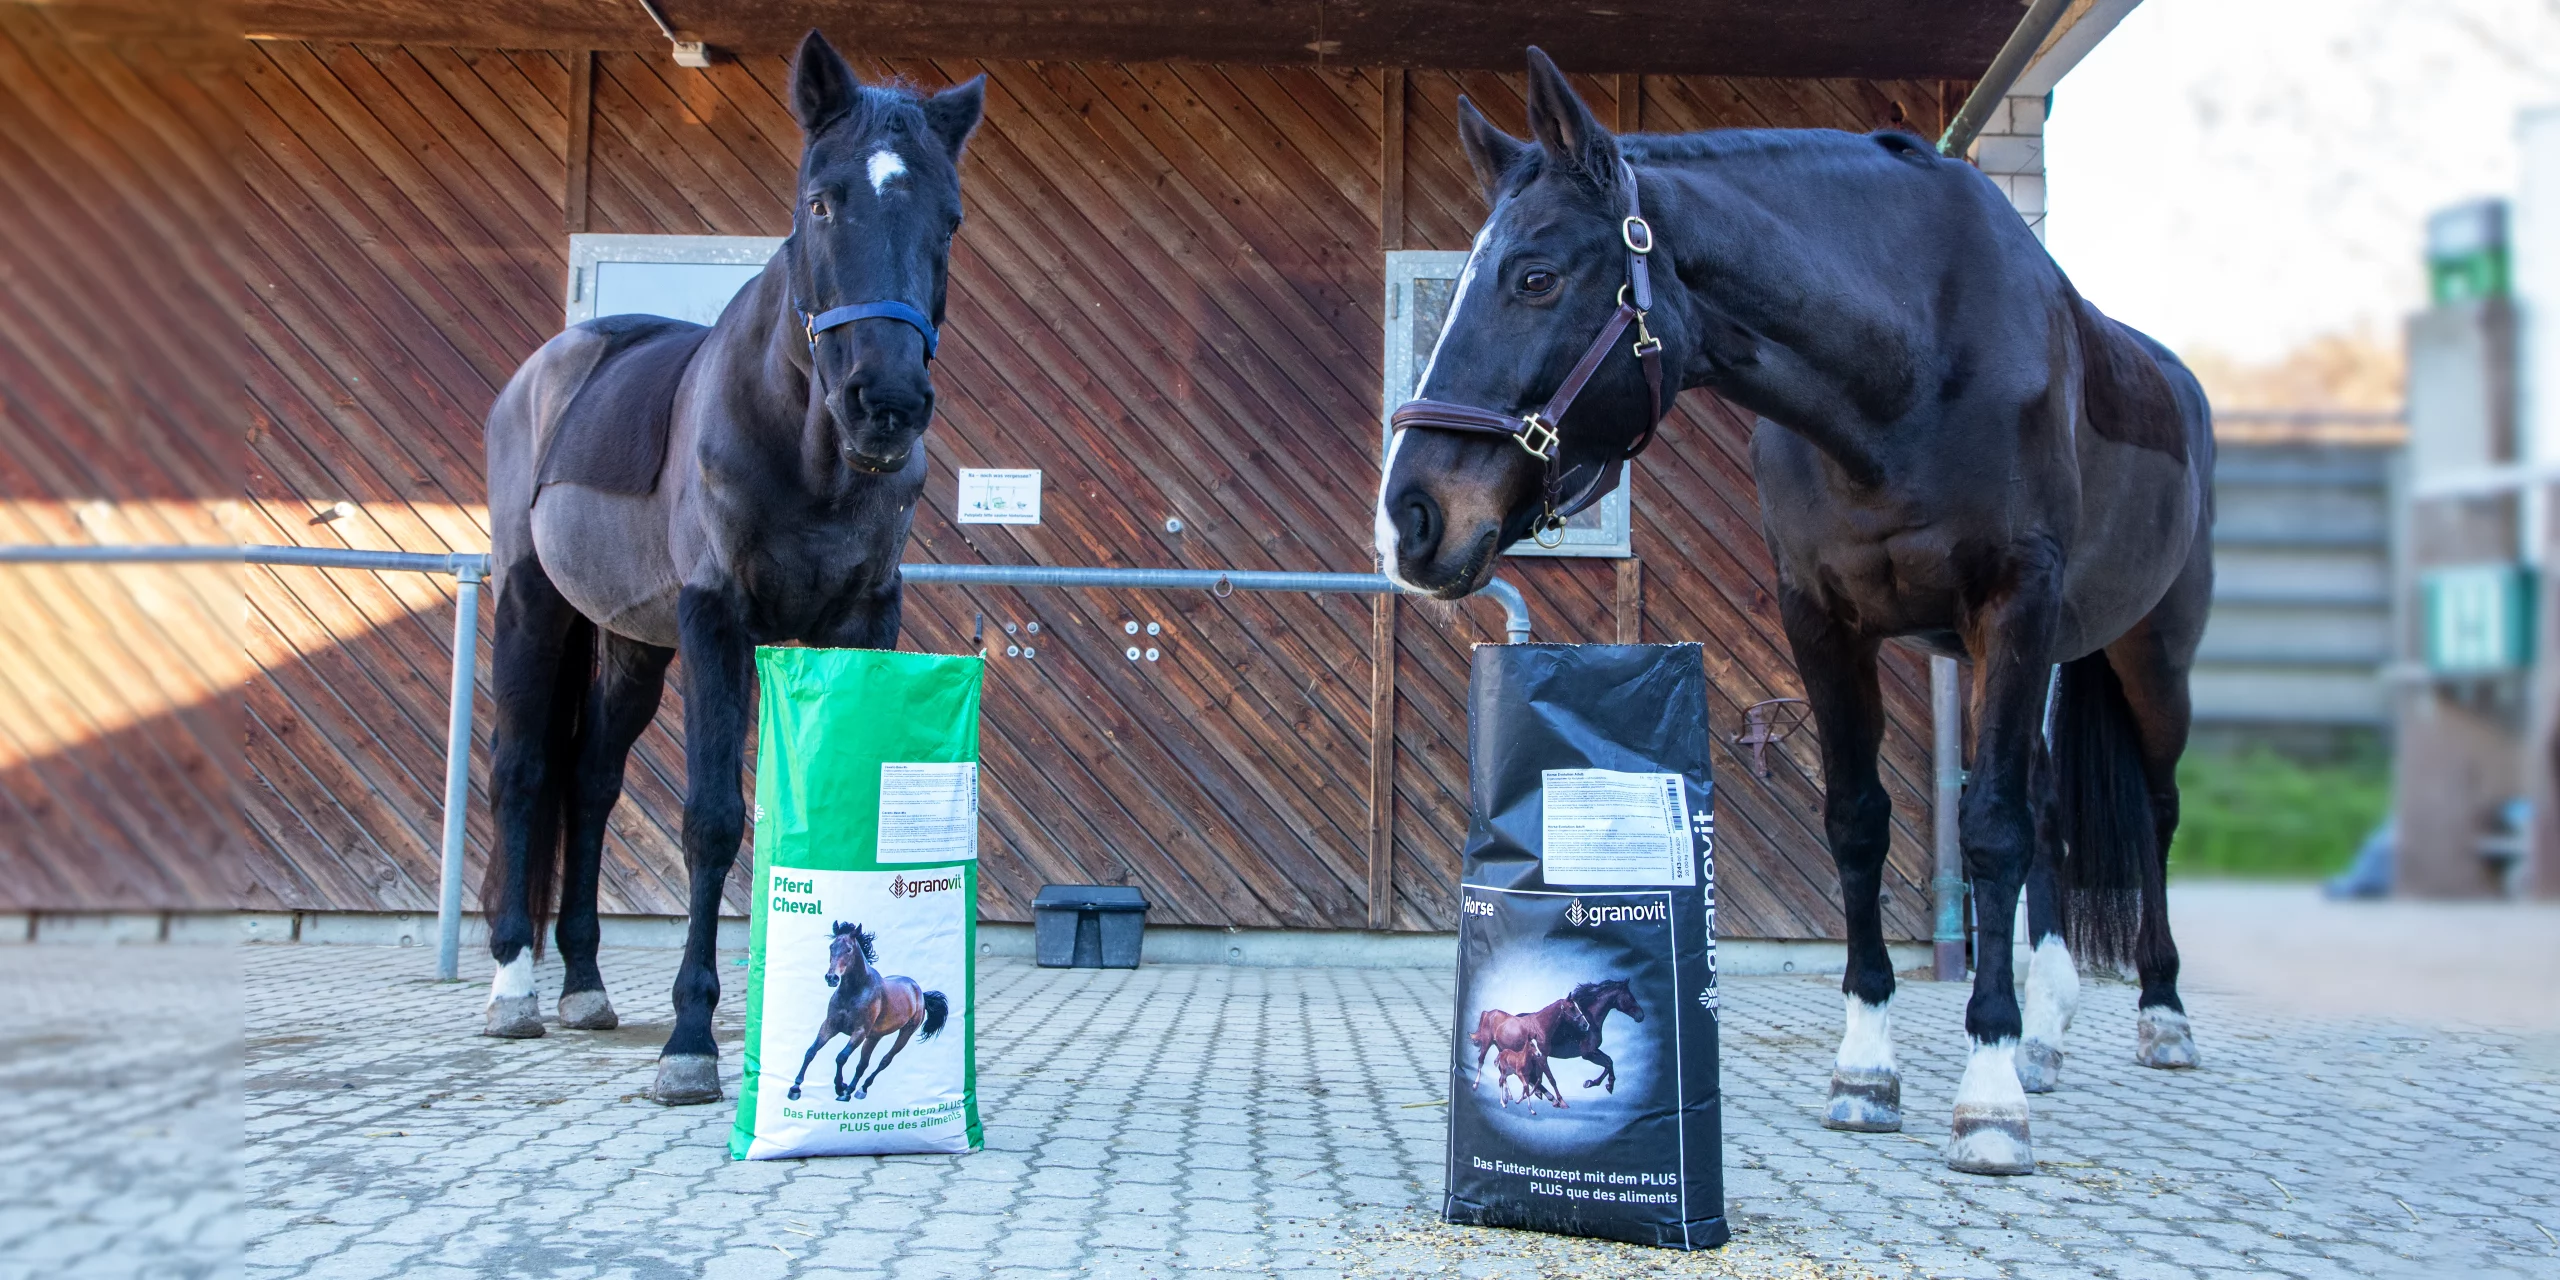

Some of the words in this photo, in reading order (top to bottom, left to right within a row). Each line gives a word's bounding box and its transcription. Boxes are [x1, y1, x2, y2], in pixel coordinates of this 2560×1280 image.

[774, 876, 813, 894] Pferd
[908, 874, 962, 898] granovit
[772, 896, 822, 915] Cheval
[1464, 896, 1494, 916] Horse
[1588, 901, 1667, 926] granovit
[784, 1107, 804, 1119] Das
[806, 1110, 888, 1121] Futterkonzept
[892, 1108, 910, 1118] mit
[913, 1106, 936, 1116] dem
[938, 1099, 962, 1112] PLUS
[840, 1122, 870, 1132] PLUS
[873, 1122, 894, 1133] que
[898, 1119, 918, 1130] des
[920, 1110, 962, 1128] aliments
[1473, 1156, 1493, 1170] Das
[1496, 1160, 1581, 1182] Futterkonzept
[1584, 1170, 1605, 1183] mit
[1608, 1172, 1638, 1184] dem
[1641, 1173, 1677, 1186] PLUS
[1530, 1182, 1563, 1196] PLUS
[1566, 1187, 1590, 1200] que
[1592, 1188, 1616, 1201] des
[1619, 1190, 1678, 1204] aliments
